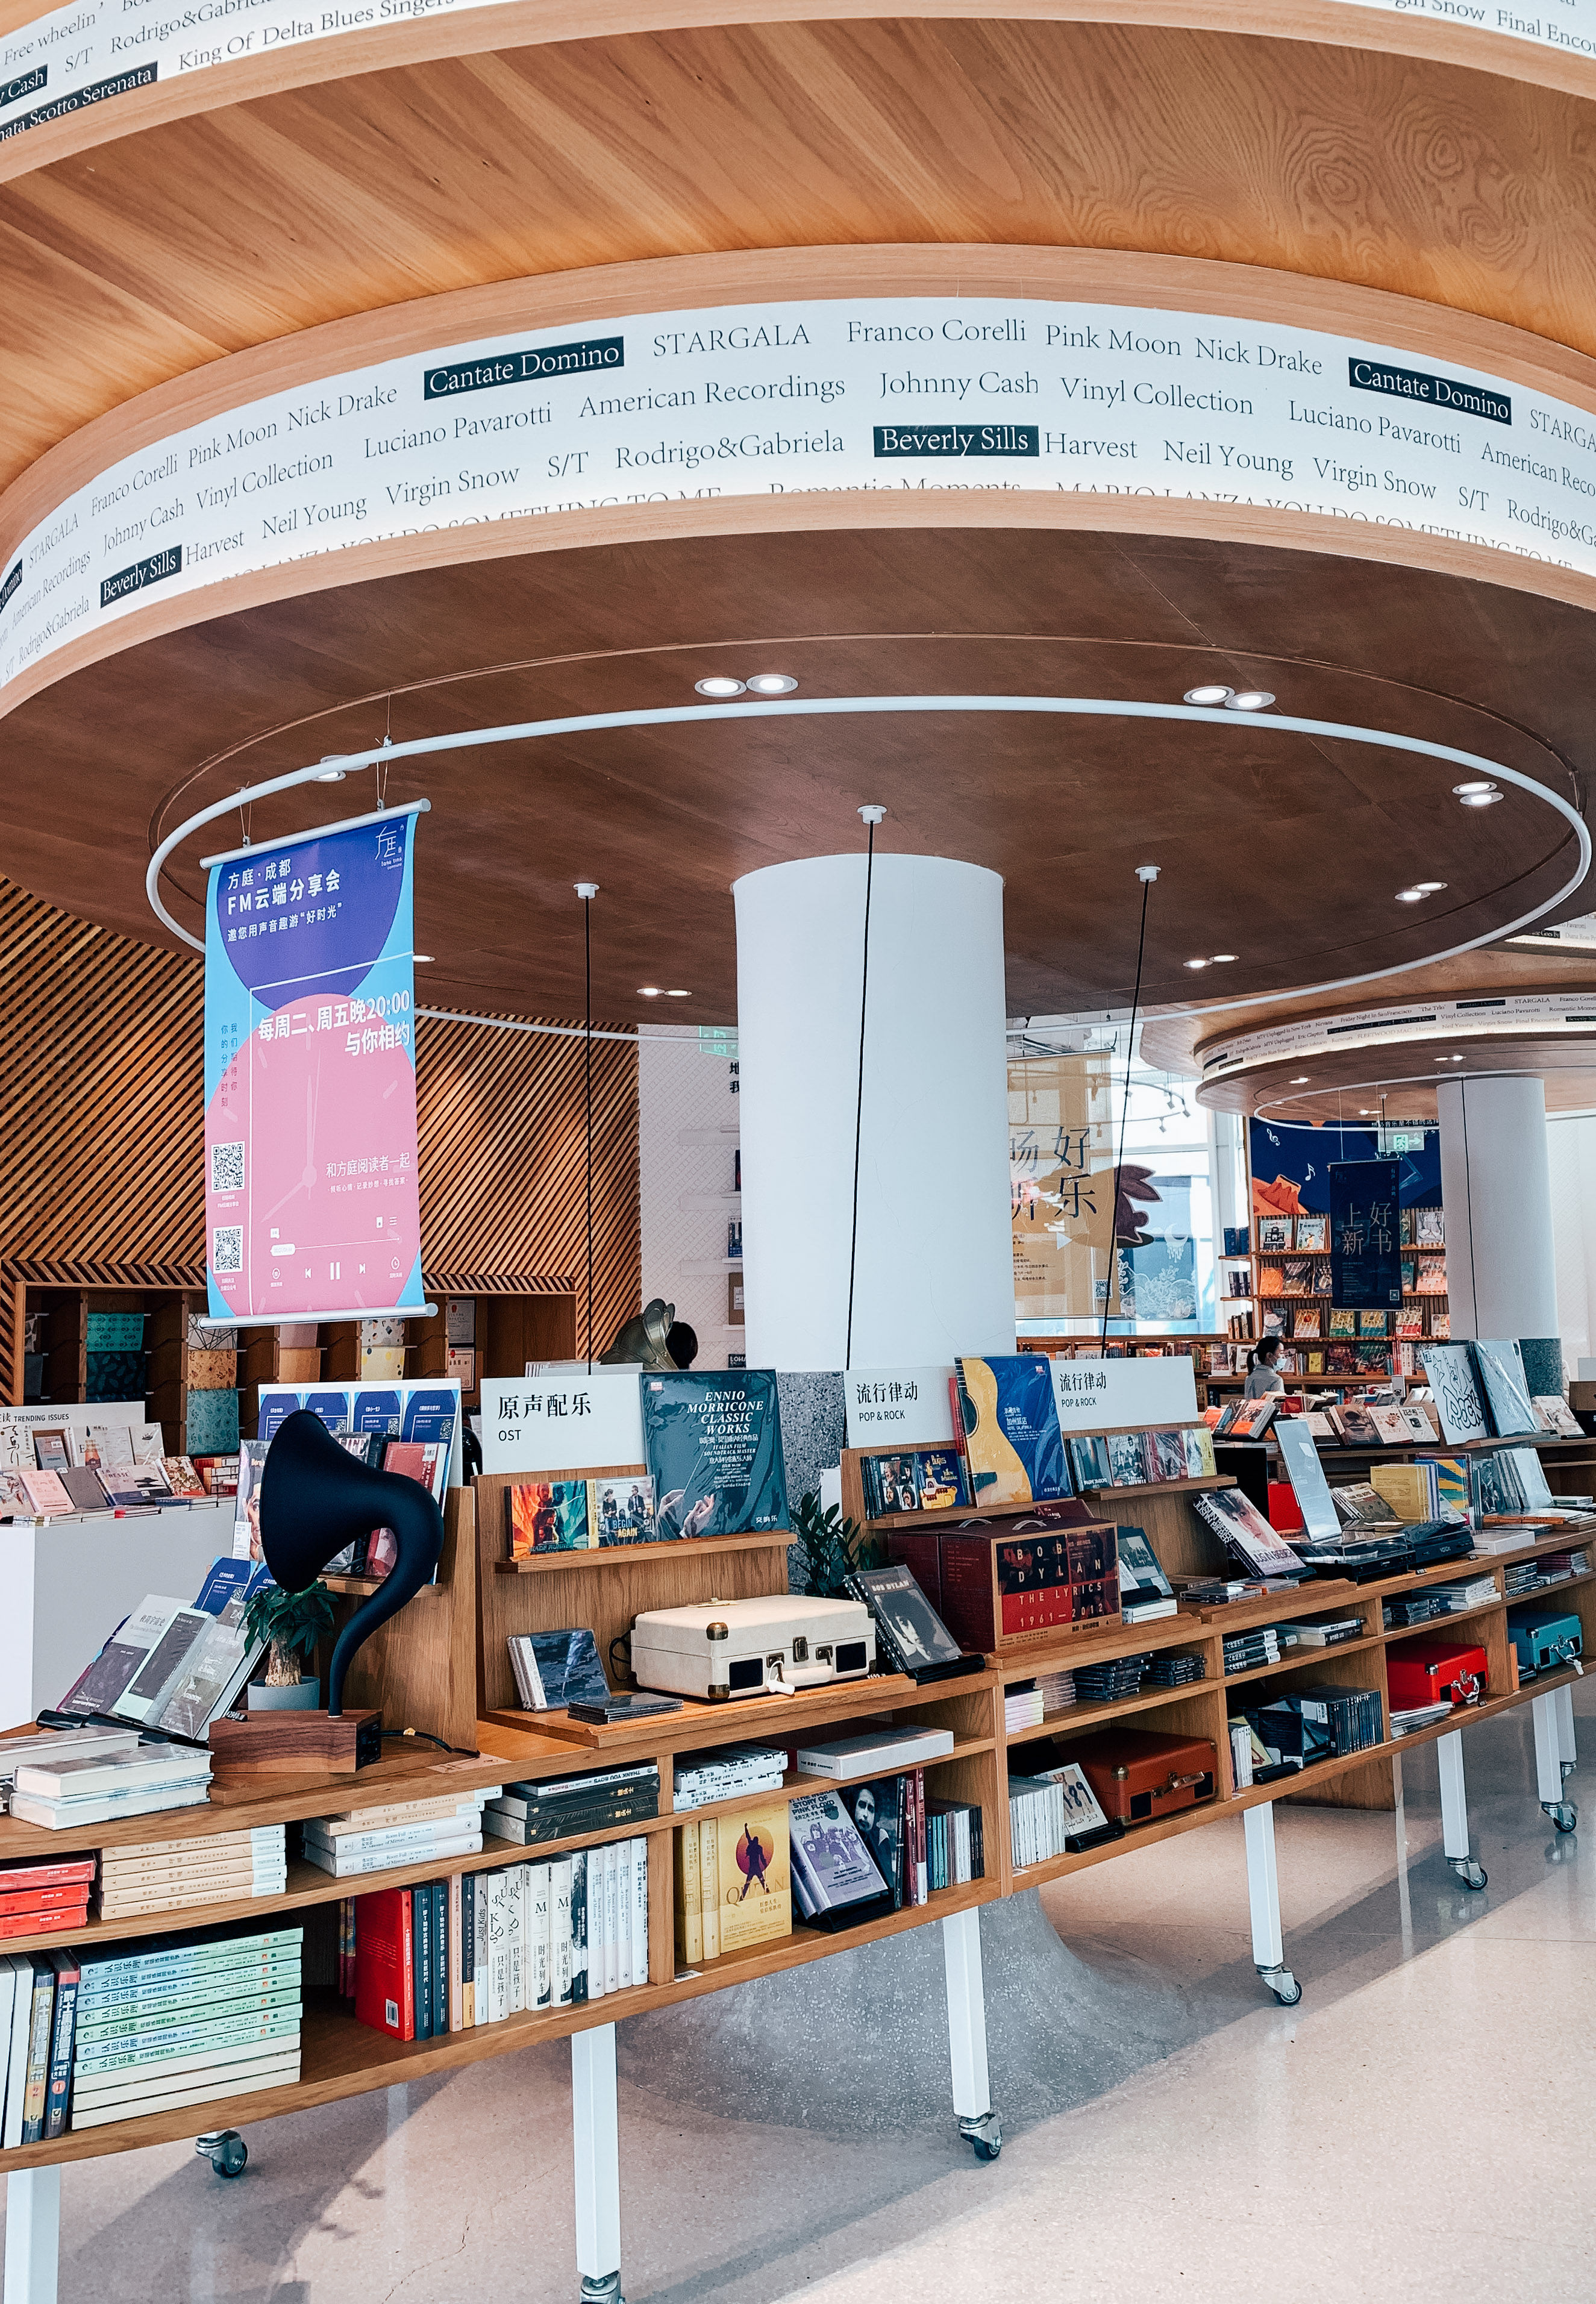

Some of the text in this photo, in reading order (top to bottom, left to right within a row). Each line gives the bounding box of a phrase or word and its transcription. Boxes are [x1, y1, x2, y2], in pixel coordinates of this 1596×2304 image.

[1497, 8, 1541, 37] Final
[4, 41, 34, 65] Free
[178, 8, 373, 70] King Of Delta Blues
[64, 46, 93, 73] S/T
[8, 70, 44, 98] Cash
[30, 69, 152, 127] Scotto Serenata
[652, 324, 812, 357] STARGALA
[847, 318, 1027, 343] Franco Corelli
[1045, 324, 1322, 375] Pink Moon Nick Drake
[429, 344, 619, 395] Cantate Domino
[578, 374, 845, 419] American Recordings
[879, 371, 1039, 401] Johnny Cash
[1059, 376, 1254, 415] Vinyl Collection
[1354, 363, 1509, 420] Cantate Domino
[189, 386, 398, 469] Pink Moon Nick Drake
[365, 402, 552, 459] Luciano Pavarotti
[881, 426, 1028, 456] Beverly Sills
[1289, 399, 1461, 454] Luciano Pavarotti
[548, 451, 590, 478] S/T
[615, 430, 845, 469] Rodrigo&Gabriela
[1045, 432, 1294, 481] Harvest Neil Young
[1481, 441, 1557, 483] American
[90, 454, 178, 516] Franco Corelli
[196, 454, 334, 512] Vinyl Collection
[386, 466, 520, 506] Virgin Snow
[1313, 456, 1437, 500] Virgin Snow
[1458, 487, 1489, 513] S/T
[102, 498, 184, 557] Johnny Cash
[263, 512, 298, 540] Neil
[303, 496, 367, 527] Young
[28, 513, 79, 569] STARGALA
[186, 531, 245, 566] Harvest
[11, 551, 91, 628] American Recordings
[103, 565, 146, 602] Beverly
[149, 551, 177, 579] Sills
[18, 596, 90, 666] Rodrigo&Gabriela
[227, 869, 341, 916] FM云端分享会
[345, 1021, 410, 1057] 与你相约
[326, 1152, 410, 1179] 和方庭阅读者一起
[1052, 1126, 1097, 1218] 好乐
[1341, 1203, 1364, 1257] 上新
[1369, 1201, 1392, 1256] 好书
[705, 1391, 745, 1401] ENNIO
[856, 1381, 919, 1404] 流行律动
[1059, 1371, 1107, 1392] 流行律动
[498, 1392, 592, 1421] 原声配乐
[686, 1401, 764, 1413] MORRICONE
[859, 1409, 906, 1423] POP & ROCK
[1061, 1397, 1097, 1407] POP & ROCK
[14, 1414, 46, 1423] TRENDING
[701, 1412, 753, 1424] CLASSIC
[707, 1423, 750, 1435] WORKS
[498, 1429, 521, 1442] OST
[613, 1518, 633, 1529] BEGIN
[618, 1527, 638, 1538] AGAIN
[1017, 1543, 1062, 1560] BOB
[886, 1580, 910, 1590] DYLAN
[1019, 1559, 1101, 1583] DYLAN
[1019, 1582, 1102, 1605] THE LYRICS
[792, 1800, 835, 1815] PINK FLOYD
[793, 1798, 817, 1809] STORY
[536, 1902, 547, 1914] M
[557, 1897, 569, 1909] M
[538, 1944, 546, 1994] 时光列车
